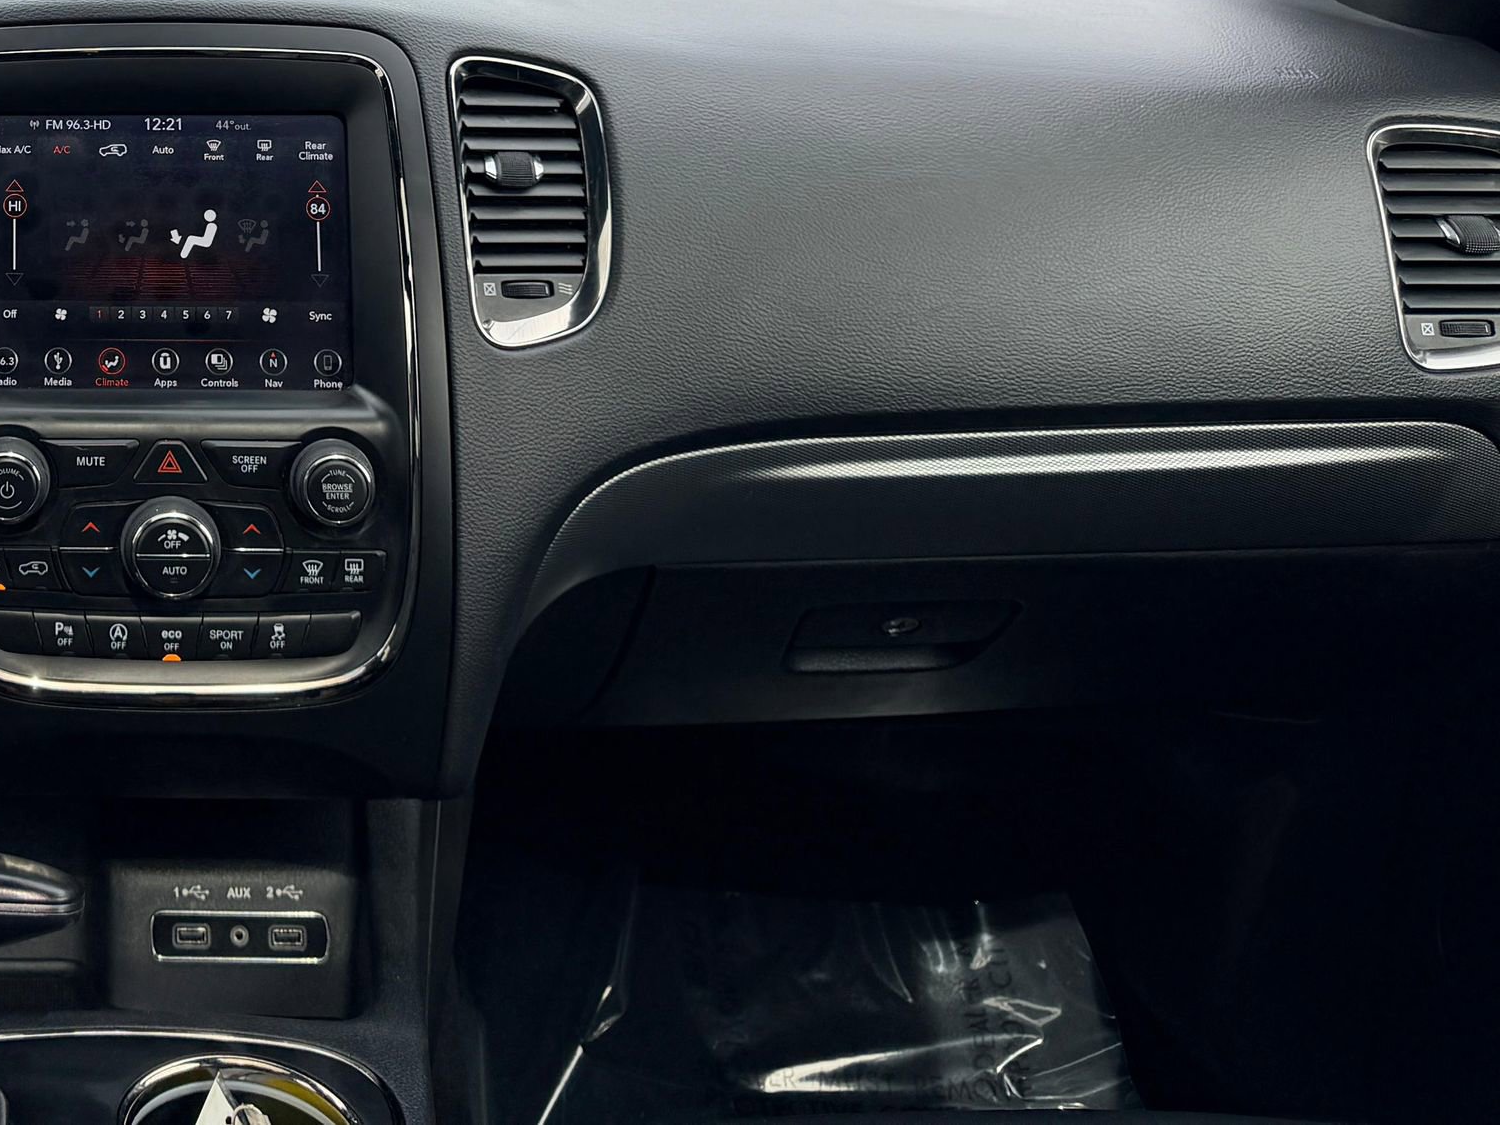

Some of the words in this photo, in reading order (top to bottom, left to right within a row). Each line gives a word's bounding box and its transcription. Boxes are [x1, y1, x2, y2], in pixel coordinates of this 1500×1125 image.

[45, 120, 63, 130] FM
[66, 120, 111, 130] 96.3-HD
[144, 118, 182, 131] 12:21
[13, 145, 32, 155] A/C
[53, 145, 71, 155] A/C
[152, 145, 174, 155] Auto
[304, 141, 326, 151] Rear
[203, 153, 224, 162] Front
[256, 153, 274, 162] Rear
[298, 151, 333, 161] Climate
[8, 201, 21, 212] HI
[310, 203, 326, 214] 84
[3, 309, 18, 319] Off
[97, 311, 102, 319] 1
[117, 311, 125, 319] 2
[139, 311, 146, 319] 3
[160, 311, 168, 319] 4
[182, 311, 190, 319] 5
[204, 311, 211, 319] 6
[225, 311, 232, 319] 7
[309, 311, 332, 323] Sync
[269, 358, 278, 368] N
[43, 377, 72, 387] Media
[95, 377, 129, 387] Climate
[154, 378, 178, 390] Apps
[200, 378, 239, 388] Controls
[264, 379, 283, 388] Nav
[313, 379, 343, 391] Phone
[76, 456, 106, 468] MUTE
[231, 455, 267, 466] SCREEN
[240, 463, 259, 473] OFF
[329, 469, 346, 477] TUNE
[322, 483, 353, 491] BROWSE
[325, 492, 350, 500] ENTER
[326, 504, 352, 513] SCROLL
[164, 539, 181, 550] OFF
[162, 565, 187, 576] AUTO
[300, 576, 324, 585] FRONT
[344, 575, 364, 584] REAR
[161, 630, 182, 639] eco
[209, 629, 244, 641] SPORT
[57, 637, 73, 647] OFF
[111, 640, 126, 650] OFF
[164, 642, 180, 651] OFF
[220, 641, 233, 651] ON
[269, 639, 286, 649] OFF
[173, 887, 179, 898] 1
[227, 887, 251, 898] AUX
[266, 887, 274, 898] 2
